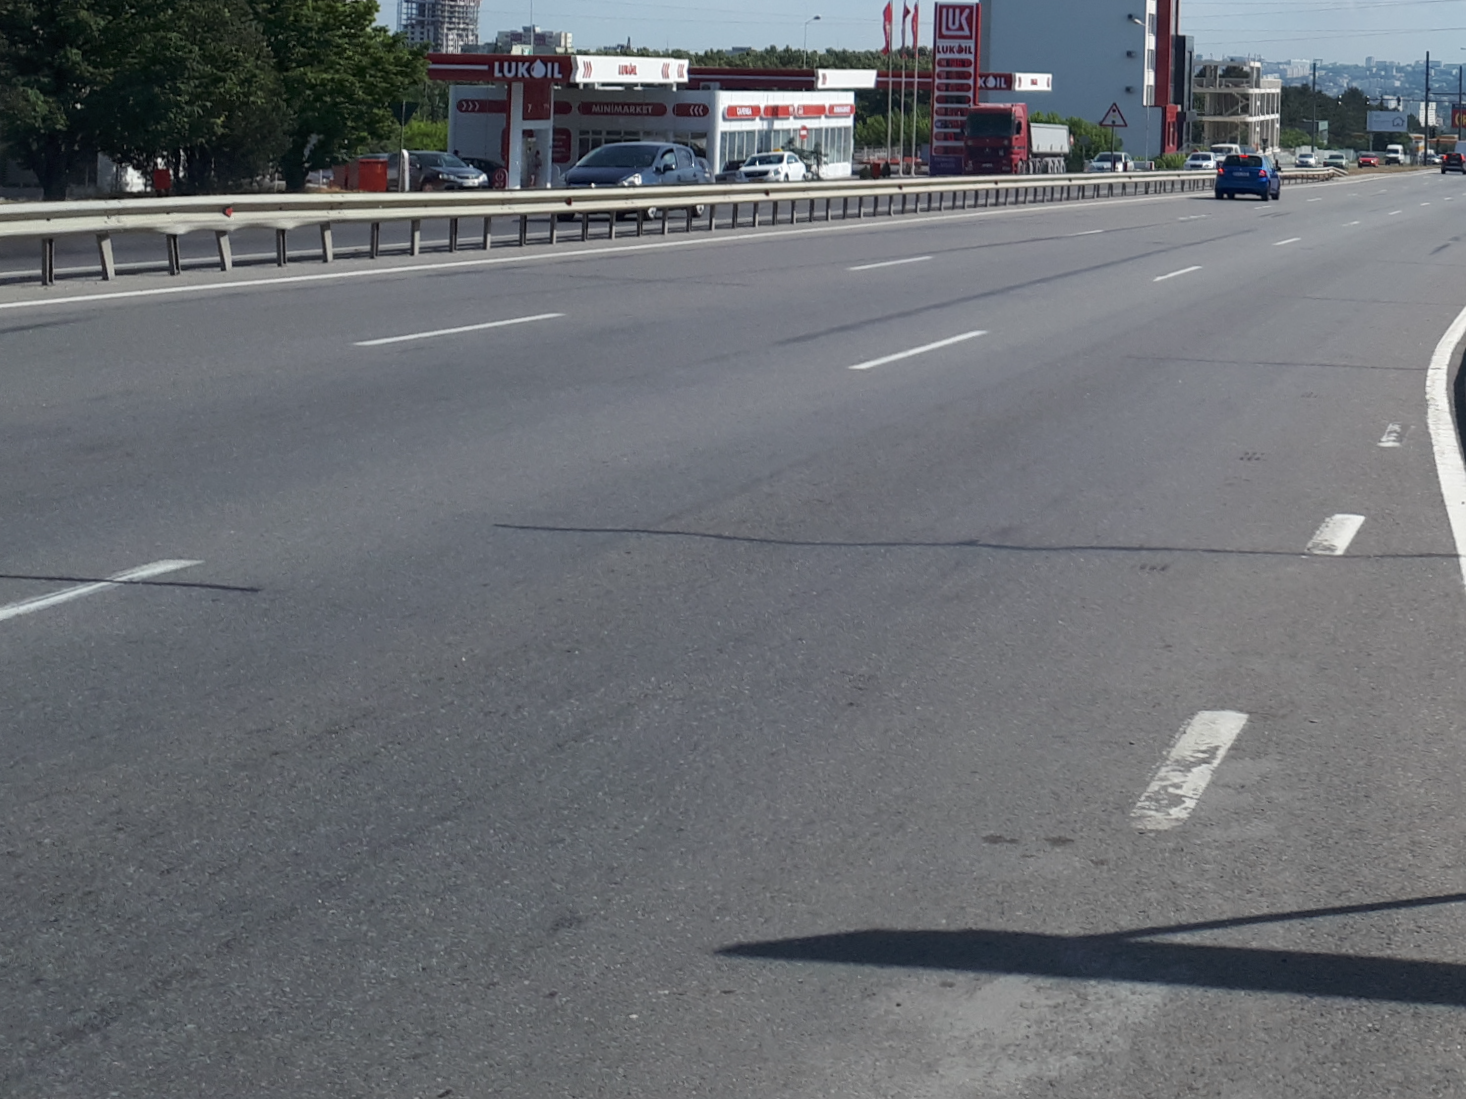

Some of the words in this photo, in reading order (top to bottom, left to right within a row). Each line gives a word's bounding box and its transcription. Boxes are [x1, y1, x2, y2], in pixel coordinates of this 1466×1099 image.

[941, 7, 971, 36] LUK
[936, 44, 973, 55] LUKOIL
[493, 58, 563, 79] LUKOIL
[978, 75, 1007, 88] KOIL
[591, 103, 654, 114] MINIMARKET
